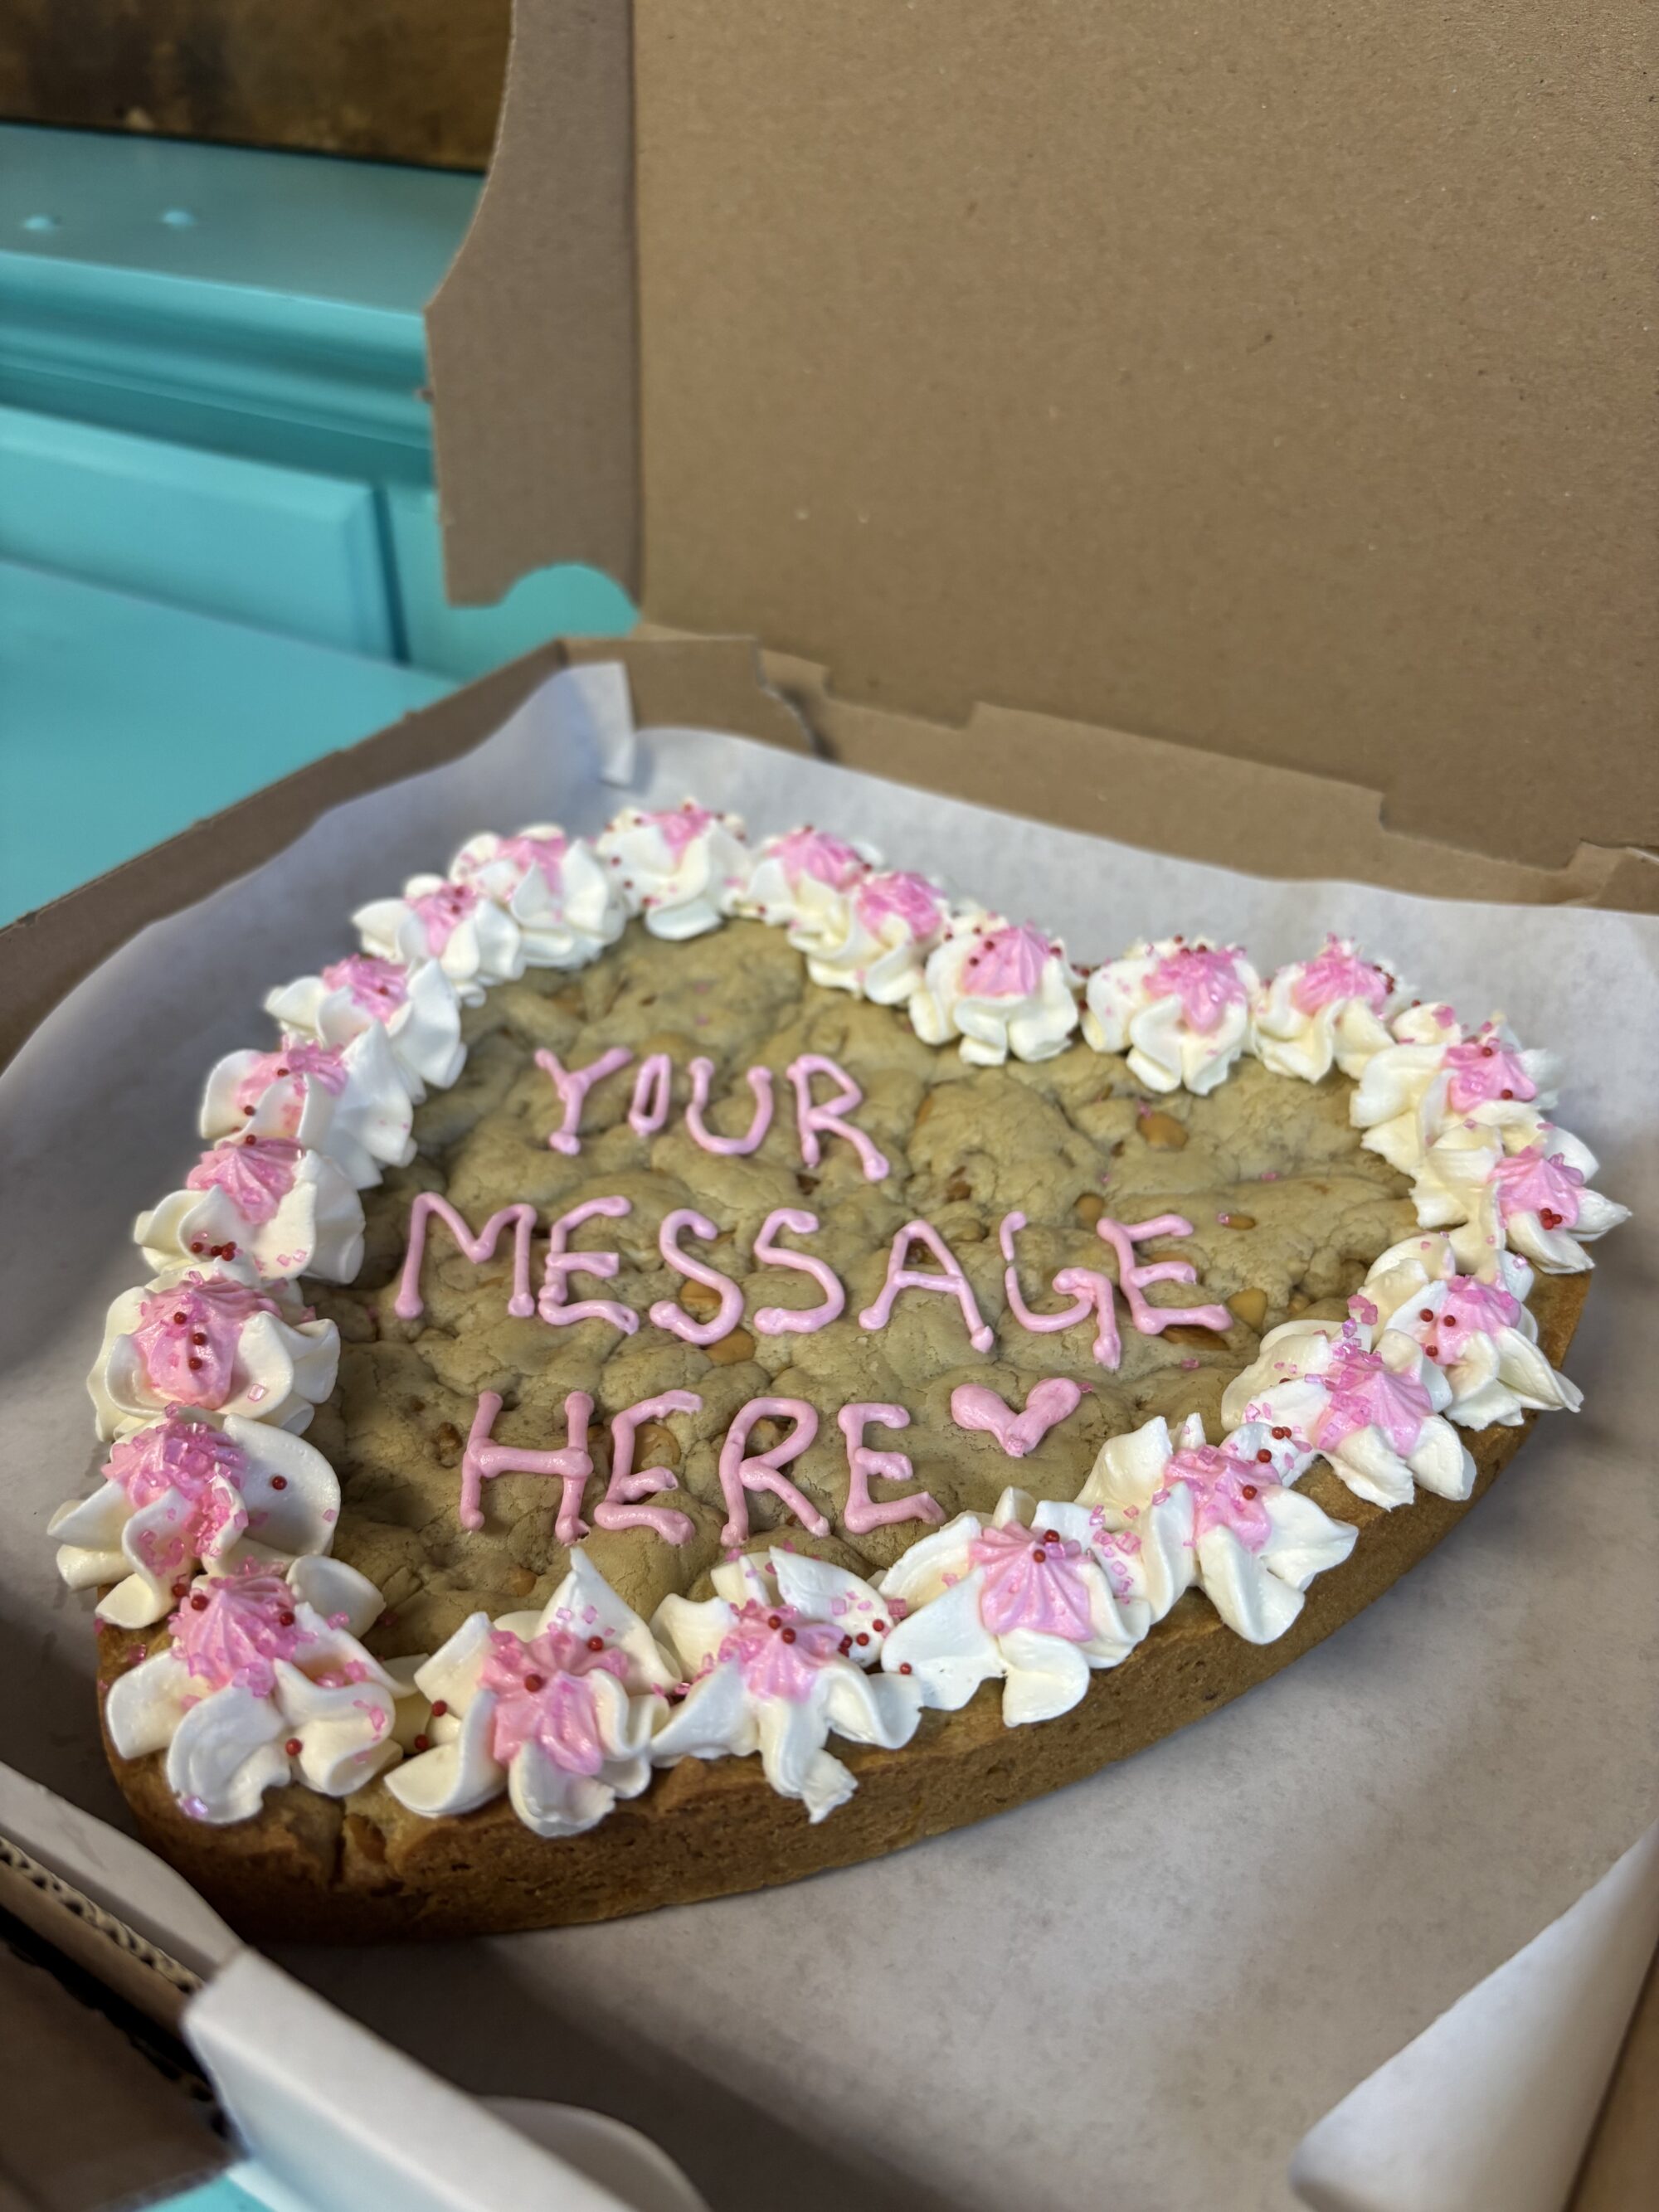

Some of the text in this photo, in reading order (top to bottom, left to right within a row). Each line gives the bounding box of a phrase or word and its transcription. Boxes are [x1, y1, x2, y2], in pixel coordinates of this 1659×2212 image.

[533, 1047, 891, 1182] YOUR
[393, 1191, 1233, 1369] MESSAGE
[460, 1388, 946, 1547] HERE
